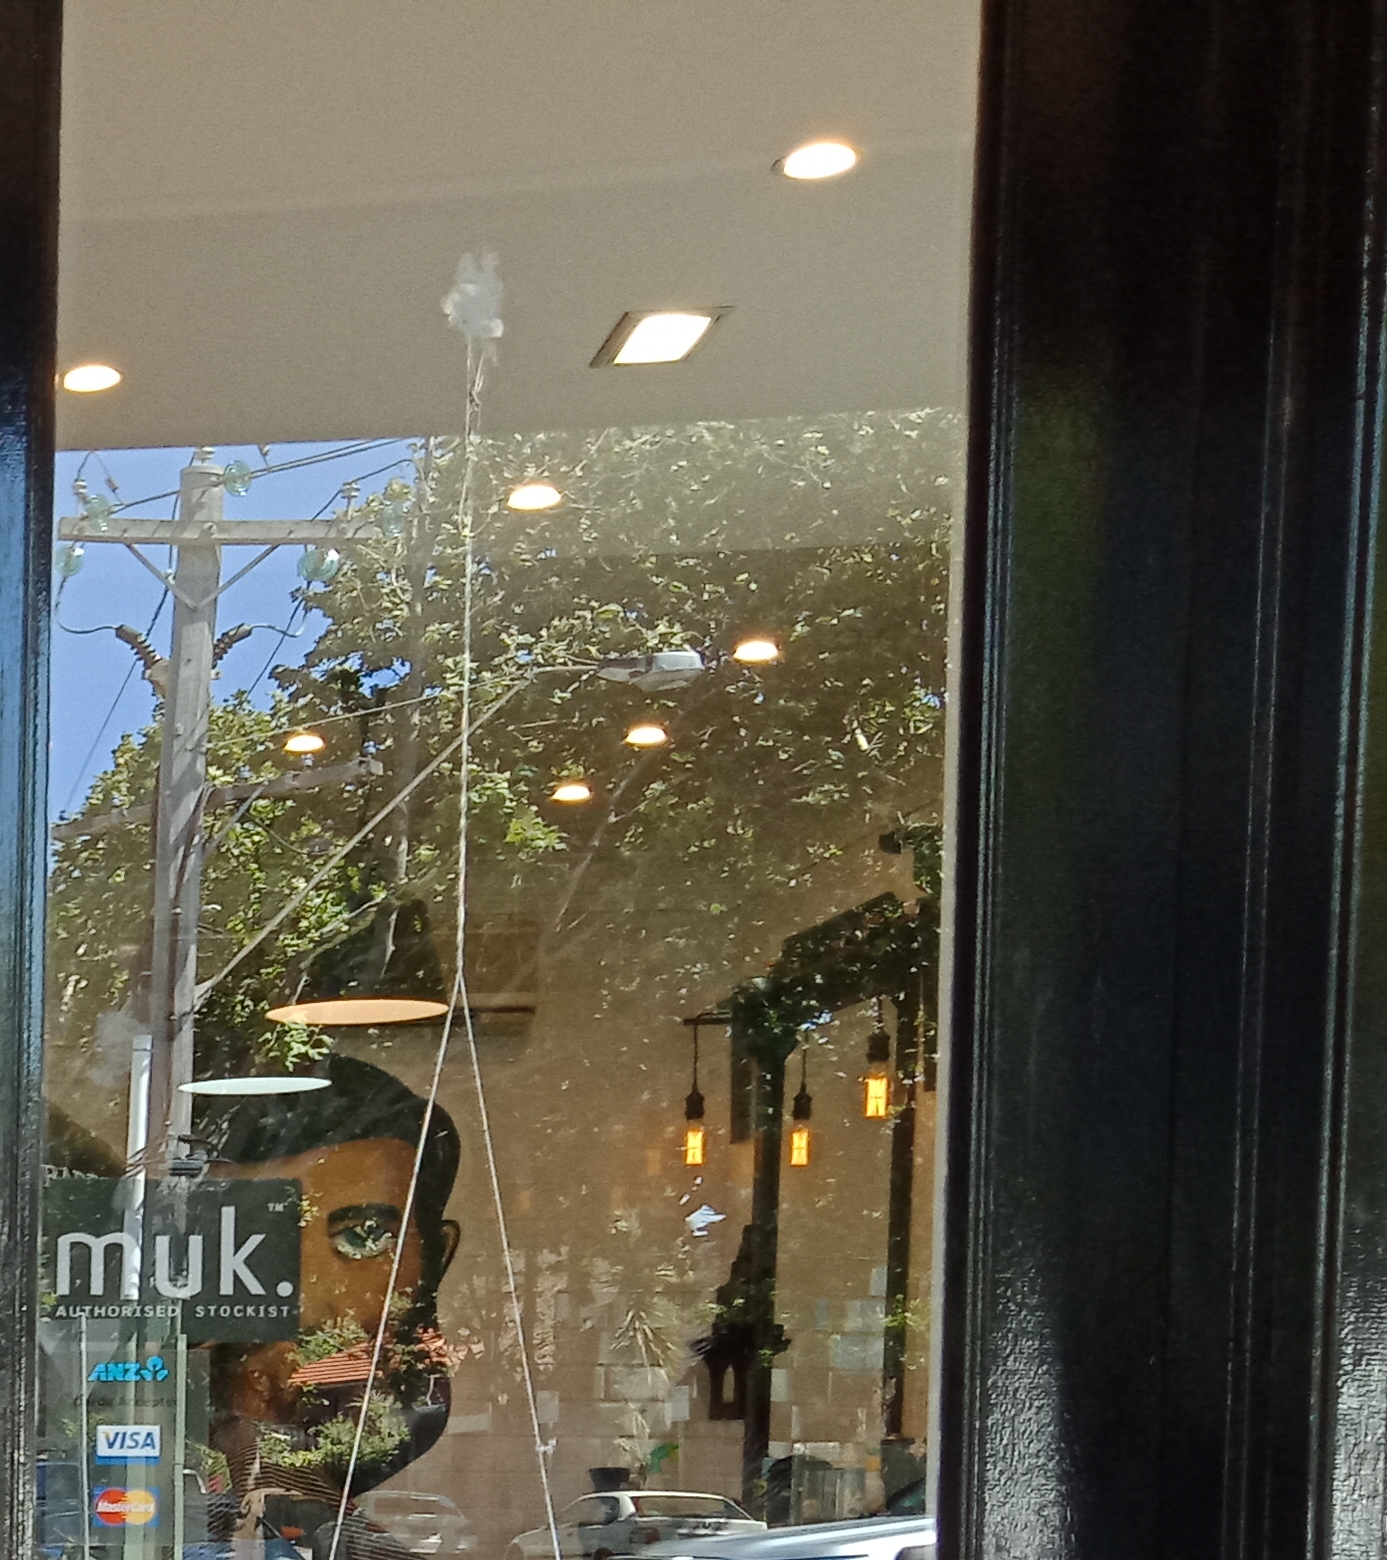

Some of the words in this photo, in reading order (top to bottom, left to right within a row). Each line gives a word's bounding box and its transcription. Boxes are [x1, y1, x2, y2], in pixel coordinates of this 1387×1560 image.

[56, 1205, 294, 1299] muk.
[55, 1304, 179, 1318] AUTHORISED
[195, 1304, 290, 1319] STOCKIST
[87, 1362, 142, 1381] ANZ
[103, 1431, 157, 1450] VISA
